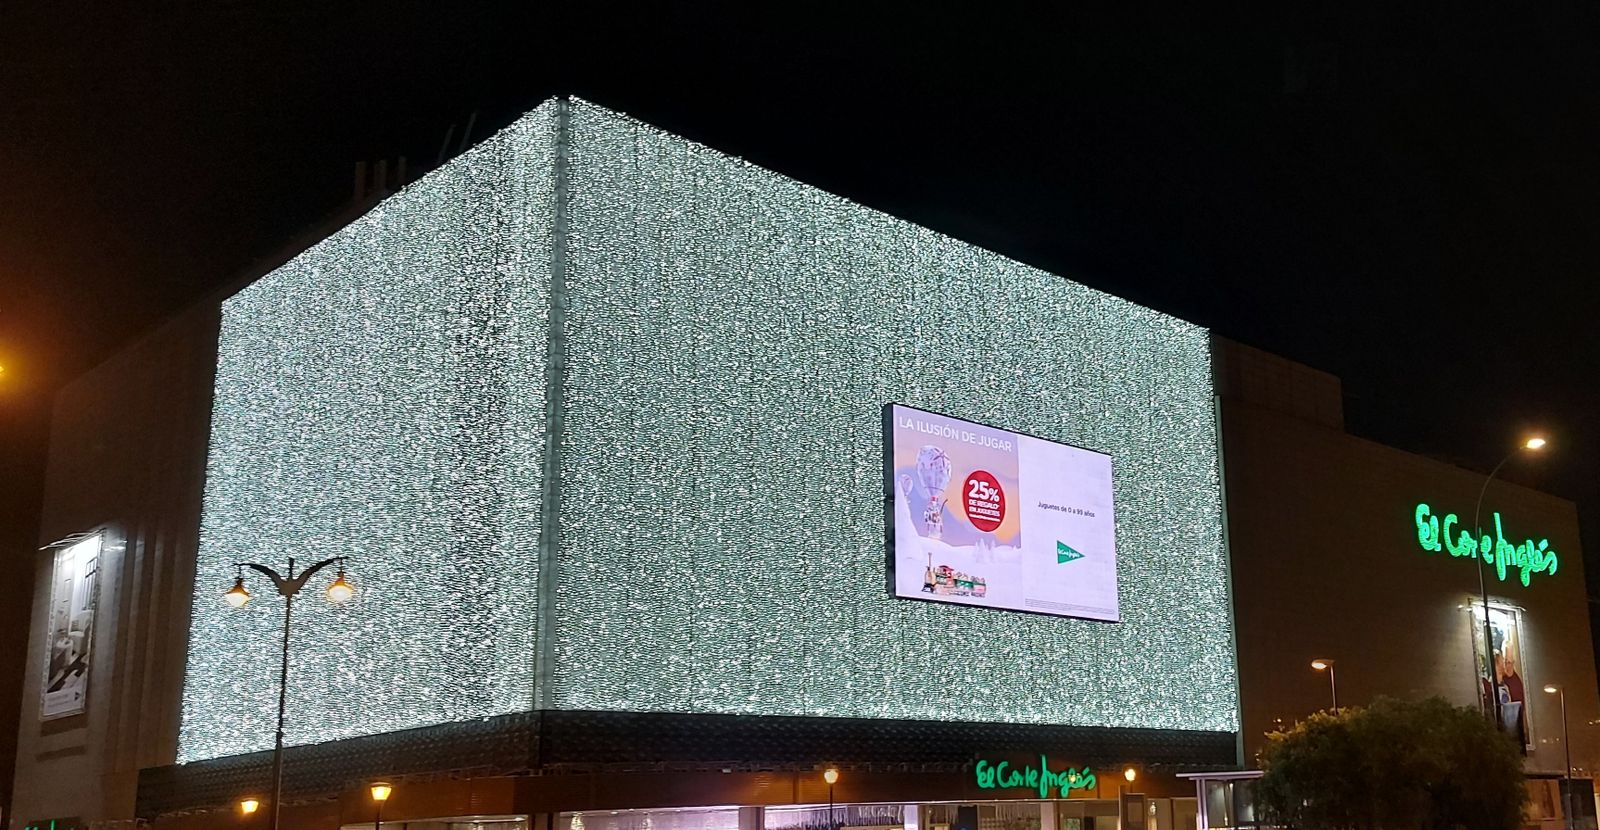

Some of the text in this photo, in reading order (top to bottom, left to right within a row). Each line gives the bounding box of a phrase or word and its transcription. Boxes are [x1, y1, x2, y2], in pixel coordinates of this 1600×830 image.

[899, 417, 1012, 452] LA ILUSIÓN DE JUGAR
[968, 479, 1000, 501] 25%
[1415, 503, 1442, 552] El
[1494, 512, 1558, 587] Inglés
[976, 754, 1096, 799] El Corte Inglés
